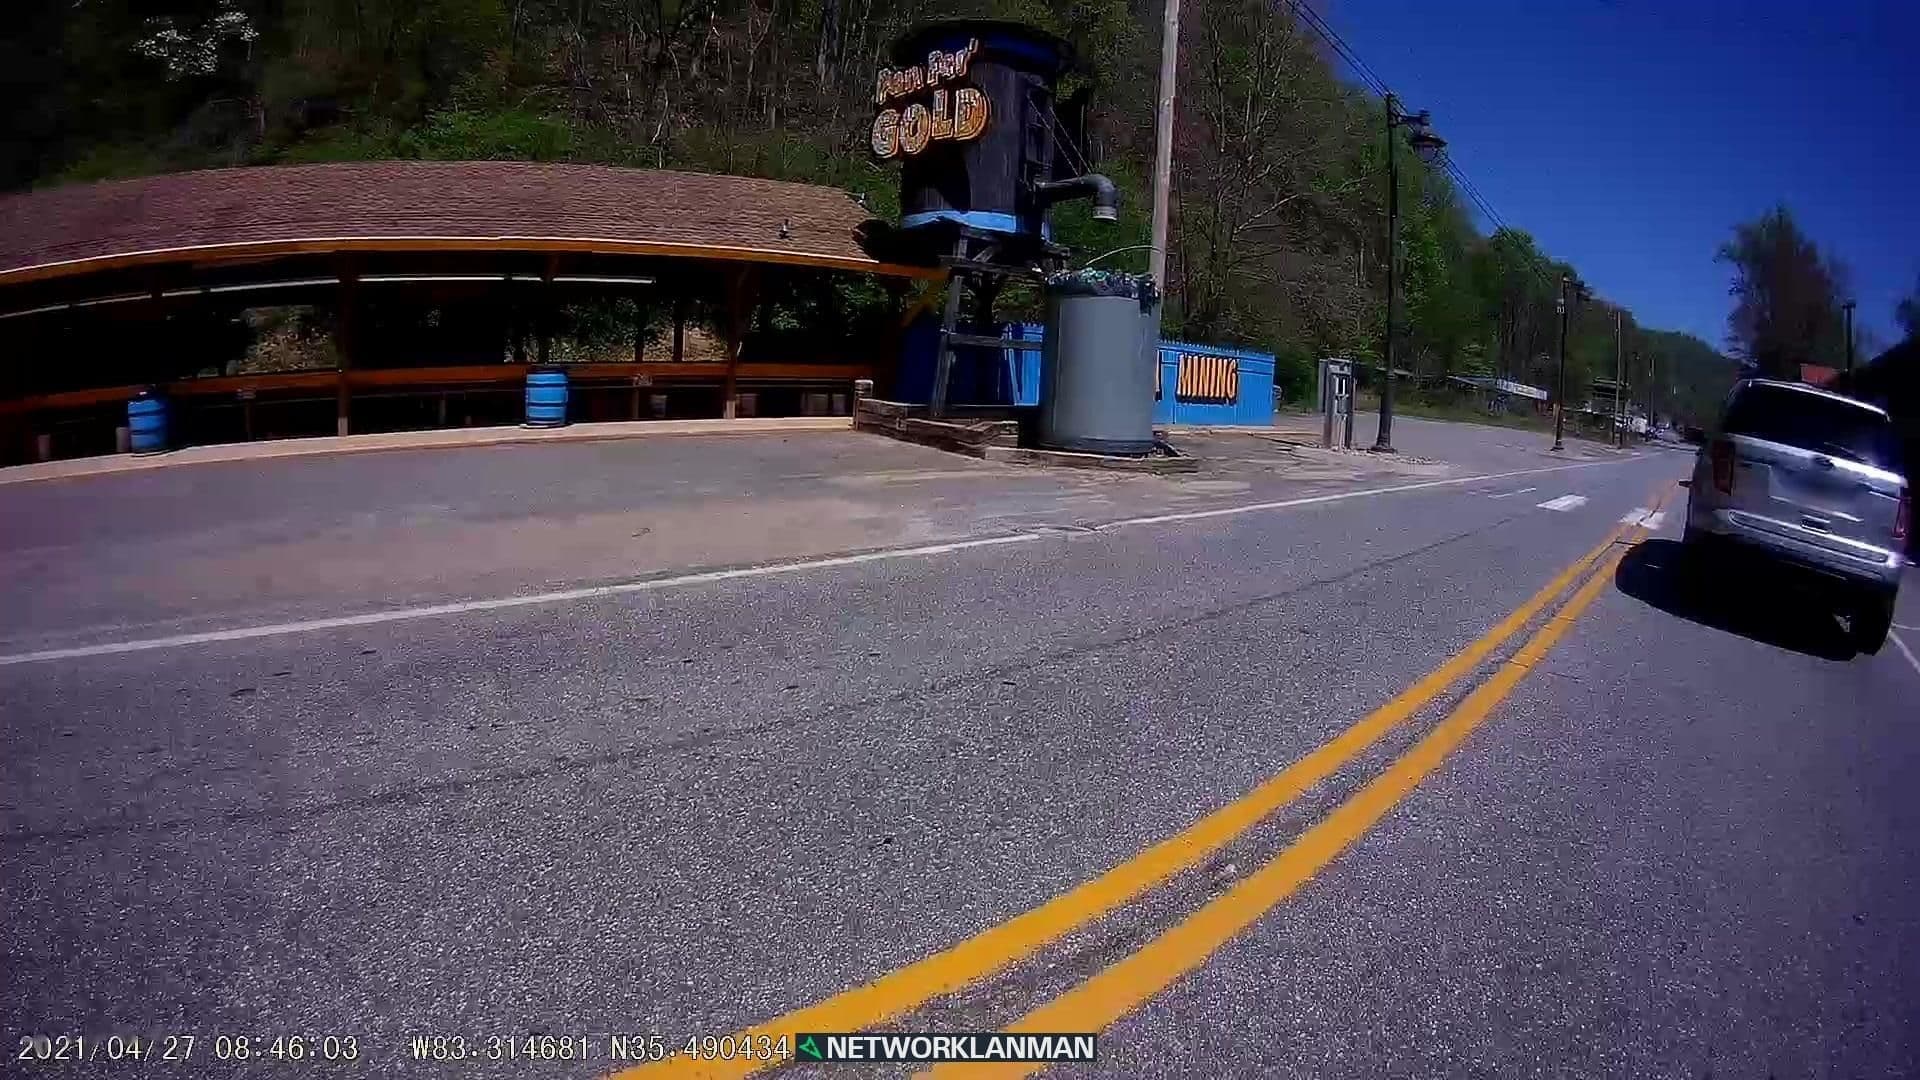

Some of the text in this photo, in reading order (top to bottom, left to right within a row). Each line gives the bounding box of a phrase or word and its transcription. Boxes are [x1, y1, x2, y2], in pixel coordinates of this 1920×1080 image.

[876, 66, 924, 105] Pan
[872, 88, 989, 158] GOLD
[1177, 354, 1237, 399] MINING
